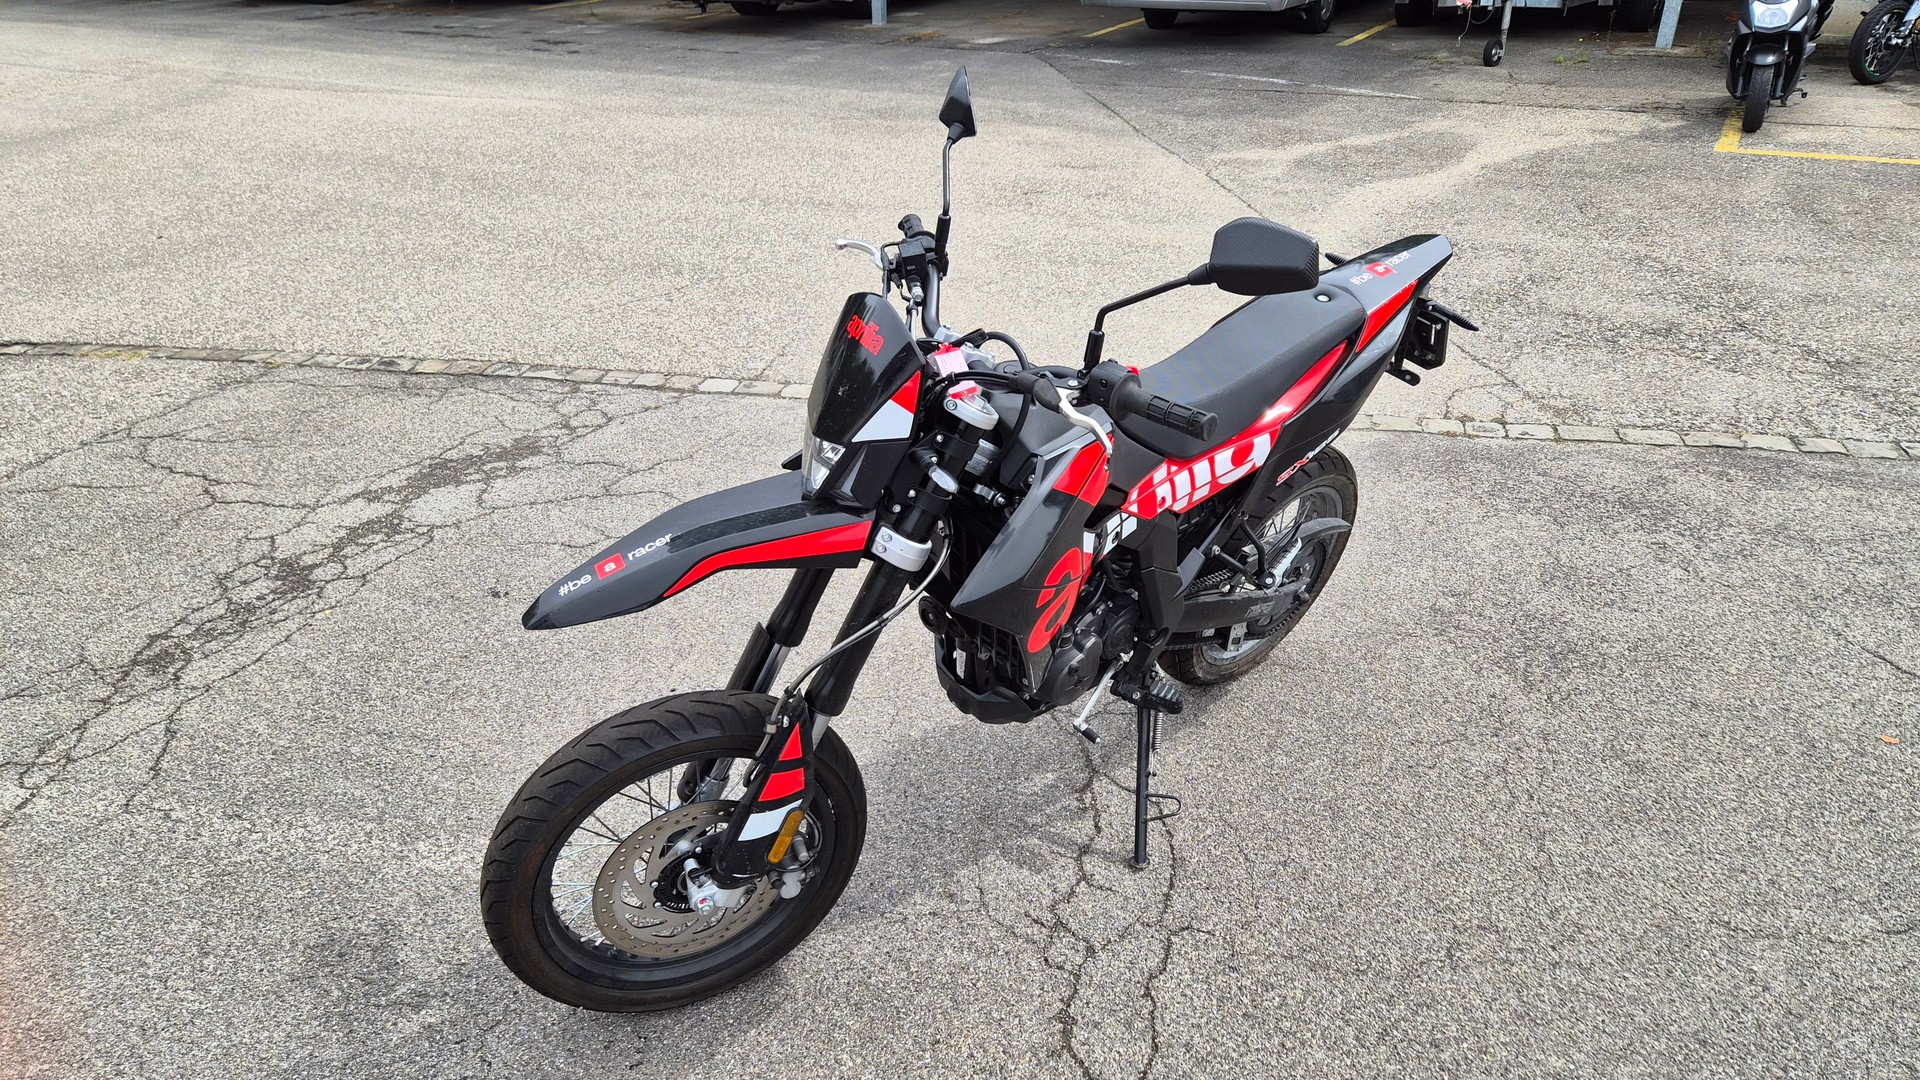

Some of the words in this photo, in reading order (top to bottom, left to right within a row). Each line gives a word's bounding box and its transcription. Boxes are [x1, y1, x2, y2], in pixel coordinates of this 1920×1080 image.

[1384, 250, 1411, 267] racer
[846, 314, 885, 357] aprilia
[558, 574, 592, 597] #be
[627, 533, 673, 561] racer
